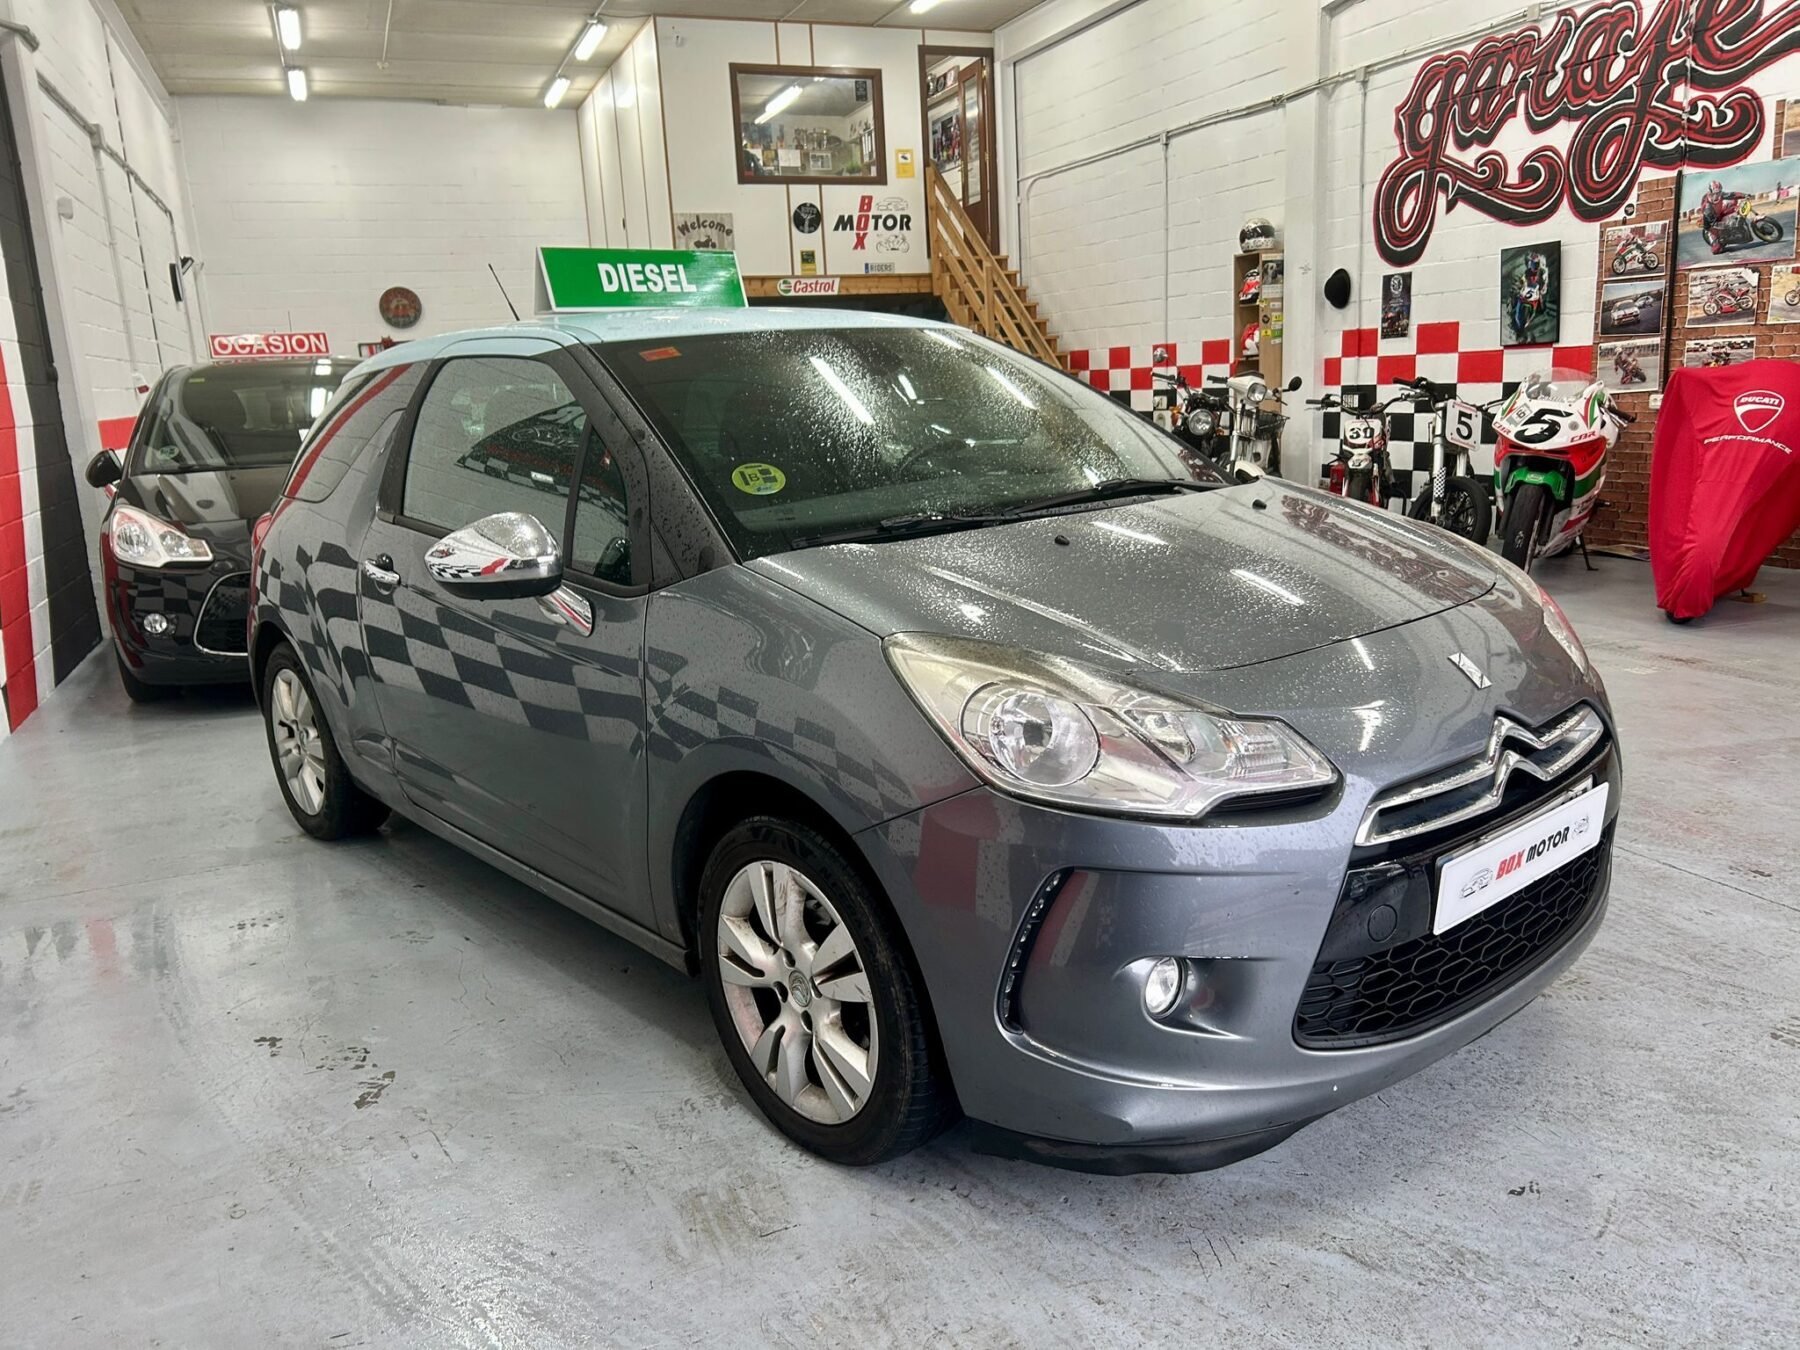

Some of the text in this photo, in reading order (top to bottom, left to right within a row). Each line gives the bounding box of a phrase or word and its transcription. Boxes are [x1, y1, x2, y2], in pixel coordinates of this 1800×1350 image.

[1374, 0, 1800, 267] garage
[677, 214, 733, 236] Welcome
[833, 214, 912, 232] MOTOR
[597, 263, 697, 292] DIESEL
[793, 280, 835, 294] Castrol
[213, 334, 327, 354] OCASION
[1740, 396, 1780, 406] DUCATI
[1455, 410, 1473, 440] 5
[1514, 408, 1574, 443] 5
[1704, 434, 1793, 455] PERFORMANCE
[1495, 826, 1570, 880] BOX MOTOR
